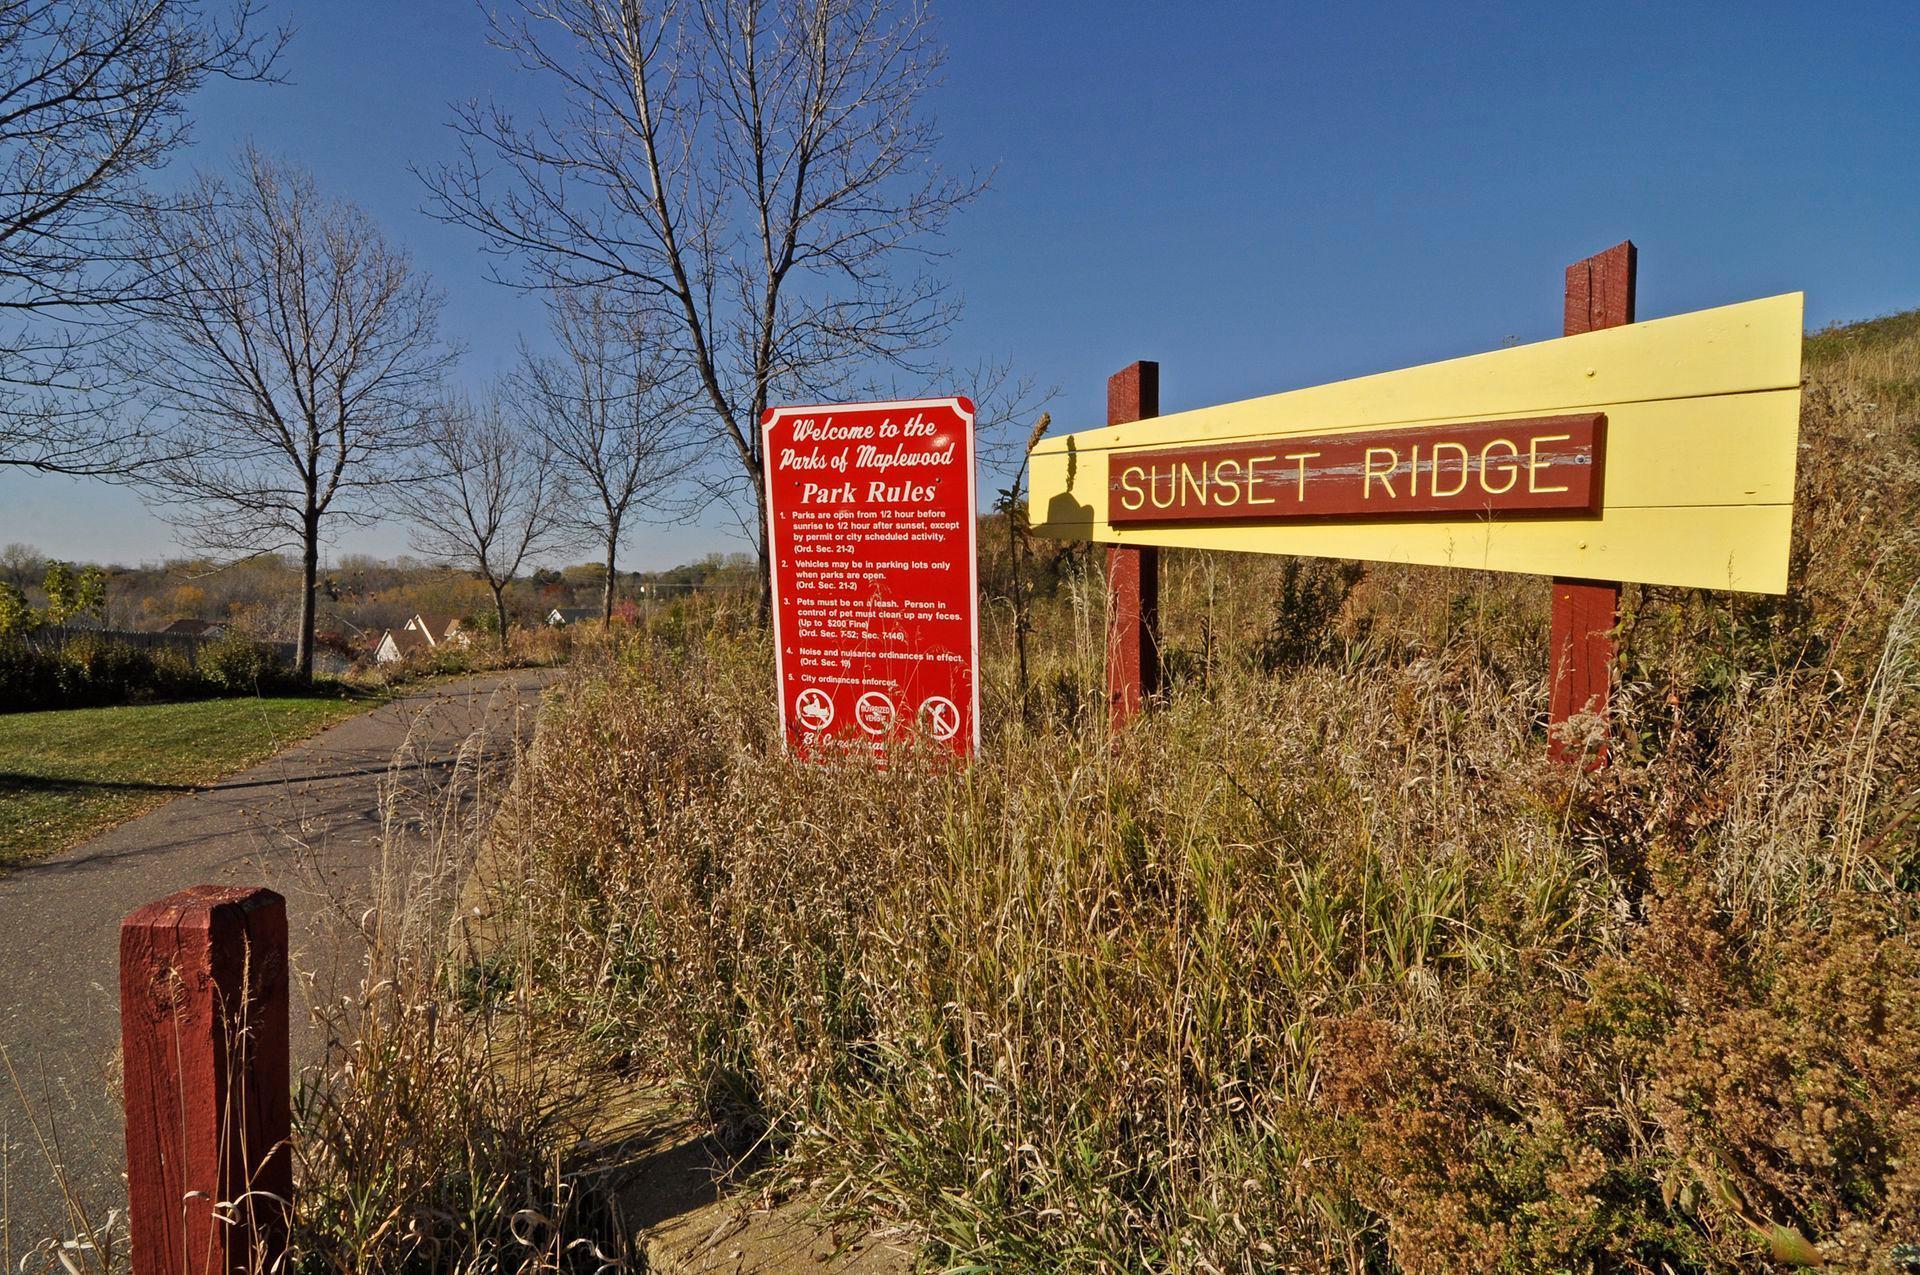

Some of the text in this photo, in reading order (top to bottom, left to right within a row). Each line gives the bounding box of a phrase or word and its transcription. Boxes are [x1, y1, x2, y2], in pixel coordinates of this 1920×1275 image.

[793, 413, 937, 442] Welcome to the
[779, 443, 955, 473] Parks of Maplewood
[1120, 434, 1570, 511] SUNSET RIDGE
[800, 481, 936, 504] Park Rules
[792, 511, 815, 519] Parks
[833, 512, 854, 521] open
[917, 510, 946, 518] before
[793, 522, 823, 530] sunrise
[825, 522, 834, 530] to
[837, 522, 848, 530] 1/2
[873, 521, 894, 529] after
[896, 521, 927, 530] sunset,
[930, 522, 959, 531] except
[793, 533, 803, 542] by
[806, 533, 833, 542] permit
[846, 533, 862, 542] city
[865, 533, 909, 541] scheduled
[911, 533, 946, 542] activity.
[794, 545, 854, 554] (Ord. Sec. 21-2)
[795, 560, 829, 568] Vehicles
[832, 561, 849, 570] may
[852, 560, 863, 568] be
[876, 561, 909, 570] parking
[911, 561, 928, 569] lots
[931, 561, 951, 571] only
[820, 571, 844, 581] parks
[863, 572, 886, 581] open.
[796, 581, 857, 591] (Ord. Sec. 21-2)
[796, 598, 815, 606] Pets
[840, 599, 851, 607] be
[874, 600, 899, 608] leash.
[904, 600, 935, 609] Person
[937, 601, 945, 609] in
[797, 609, 827, 617] control
[839, 610, 853, 619] pet
[878, 611, 901, 619] clean
[904, 612, 915, 621] up
[917, 612, 933, 621] any
[935, 612, 962, 621] feces.
[798, 620, 812, 628] (Up
[827, 620, 846, 628] $200
[849, 620, 869, 629] Fine)
[799, 629, 905, 641] (Ord. Sec. 7-52; Sec. 7-146)
[799, 648, 822, 656] Noise
[824, 649, 839, 657] and
[841, 650, 876, 658] nuisance
[878, 651, 923, 660] ordinances
[937, 653, 964, 662] effect.
[800, 658, 819, 667] (Ord.
[841, 659, 851, 668] 19)
[801, 674, 816, 684] City
[818, 676, 860, 685] ordinances
[862, 678, 899, 687] enforced.
